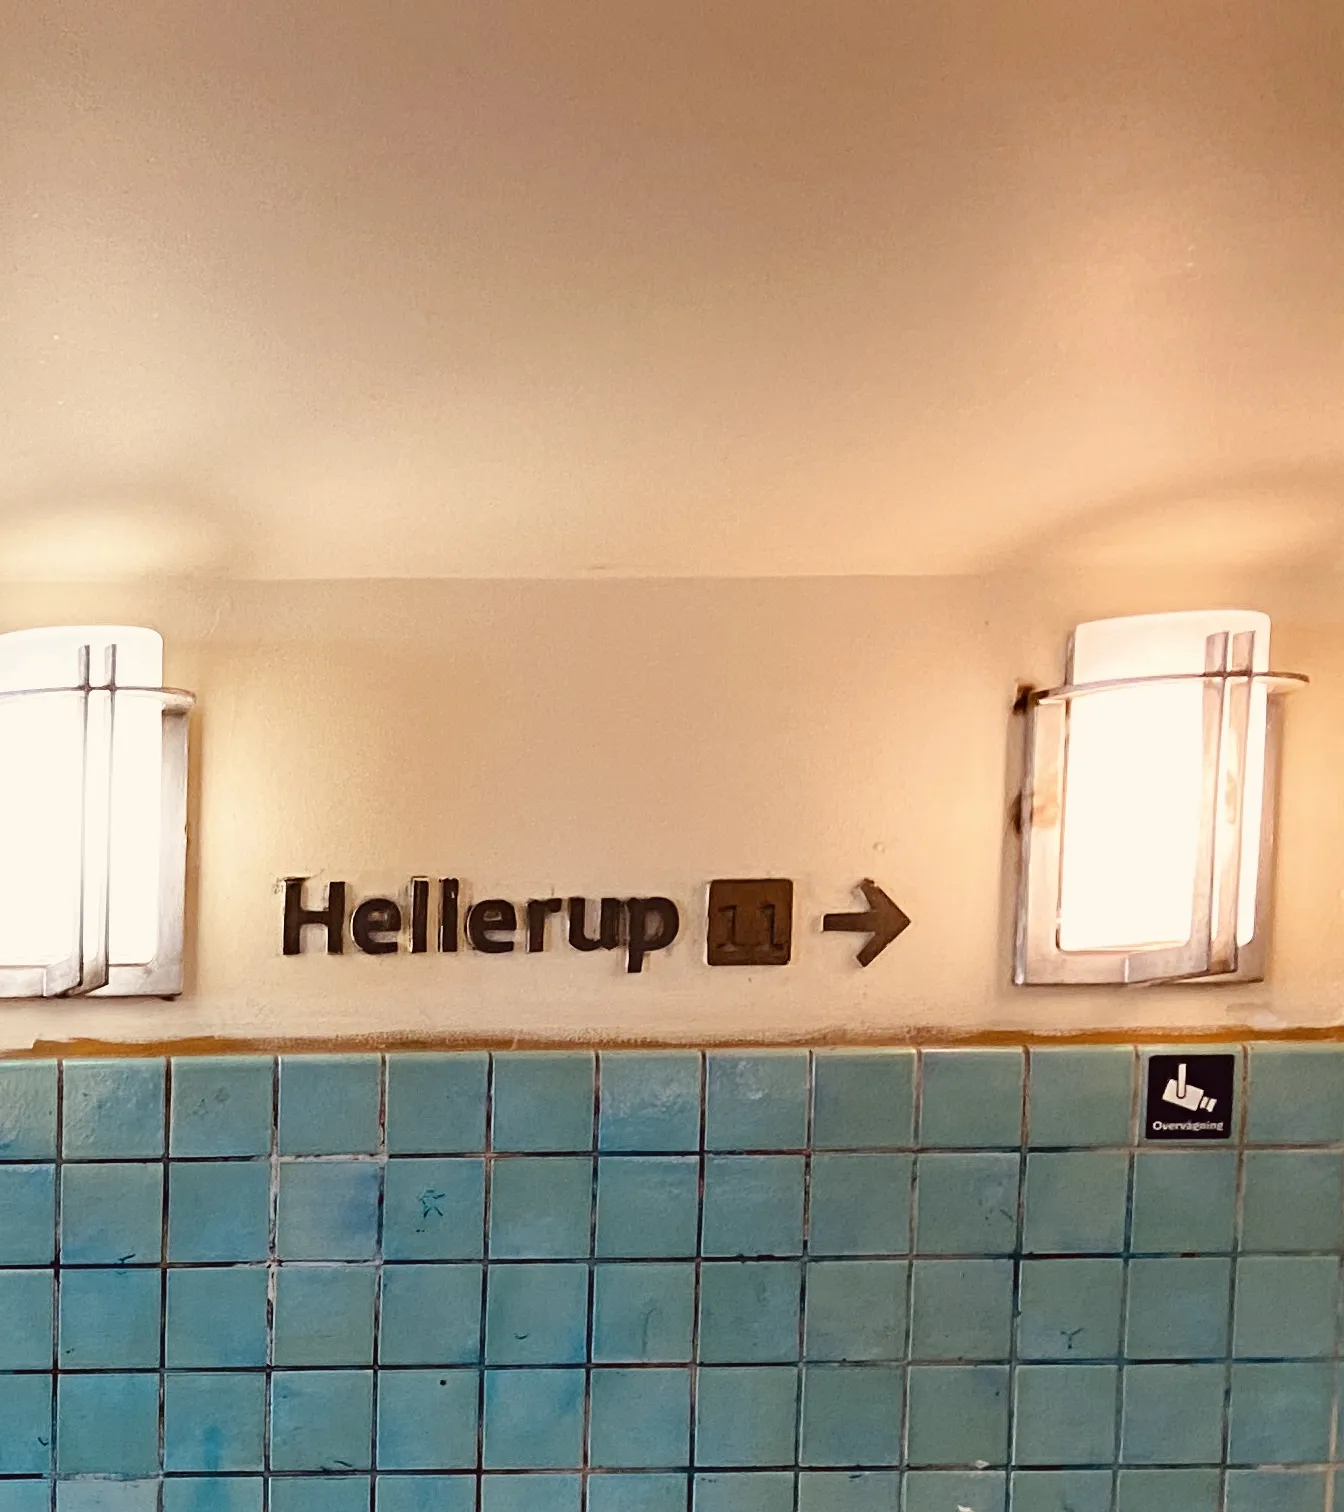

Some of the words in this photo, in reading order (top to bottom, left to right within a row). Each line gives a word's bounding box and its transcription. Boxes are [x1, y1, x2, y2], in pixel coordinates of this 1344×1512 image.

[282, 876, 680, 974] Hellerup
[716, 903, 785, 952] 11
[1152, 1120, 1224, 1131] Overvågning
